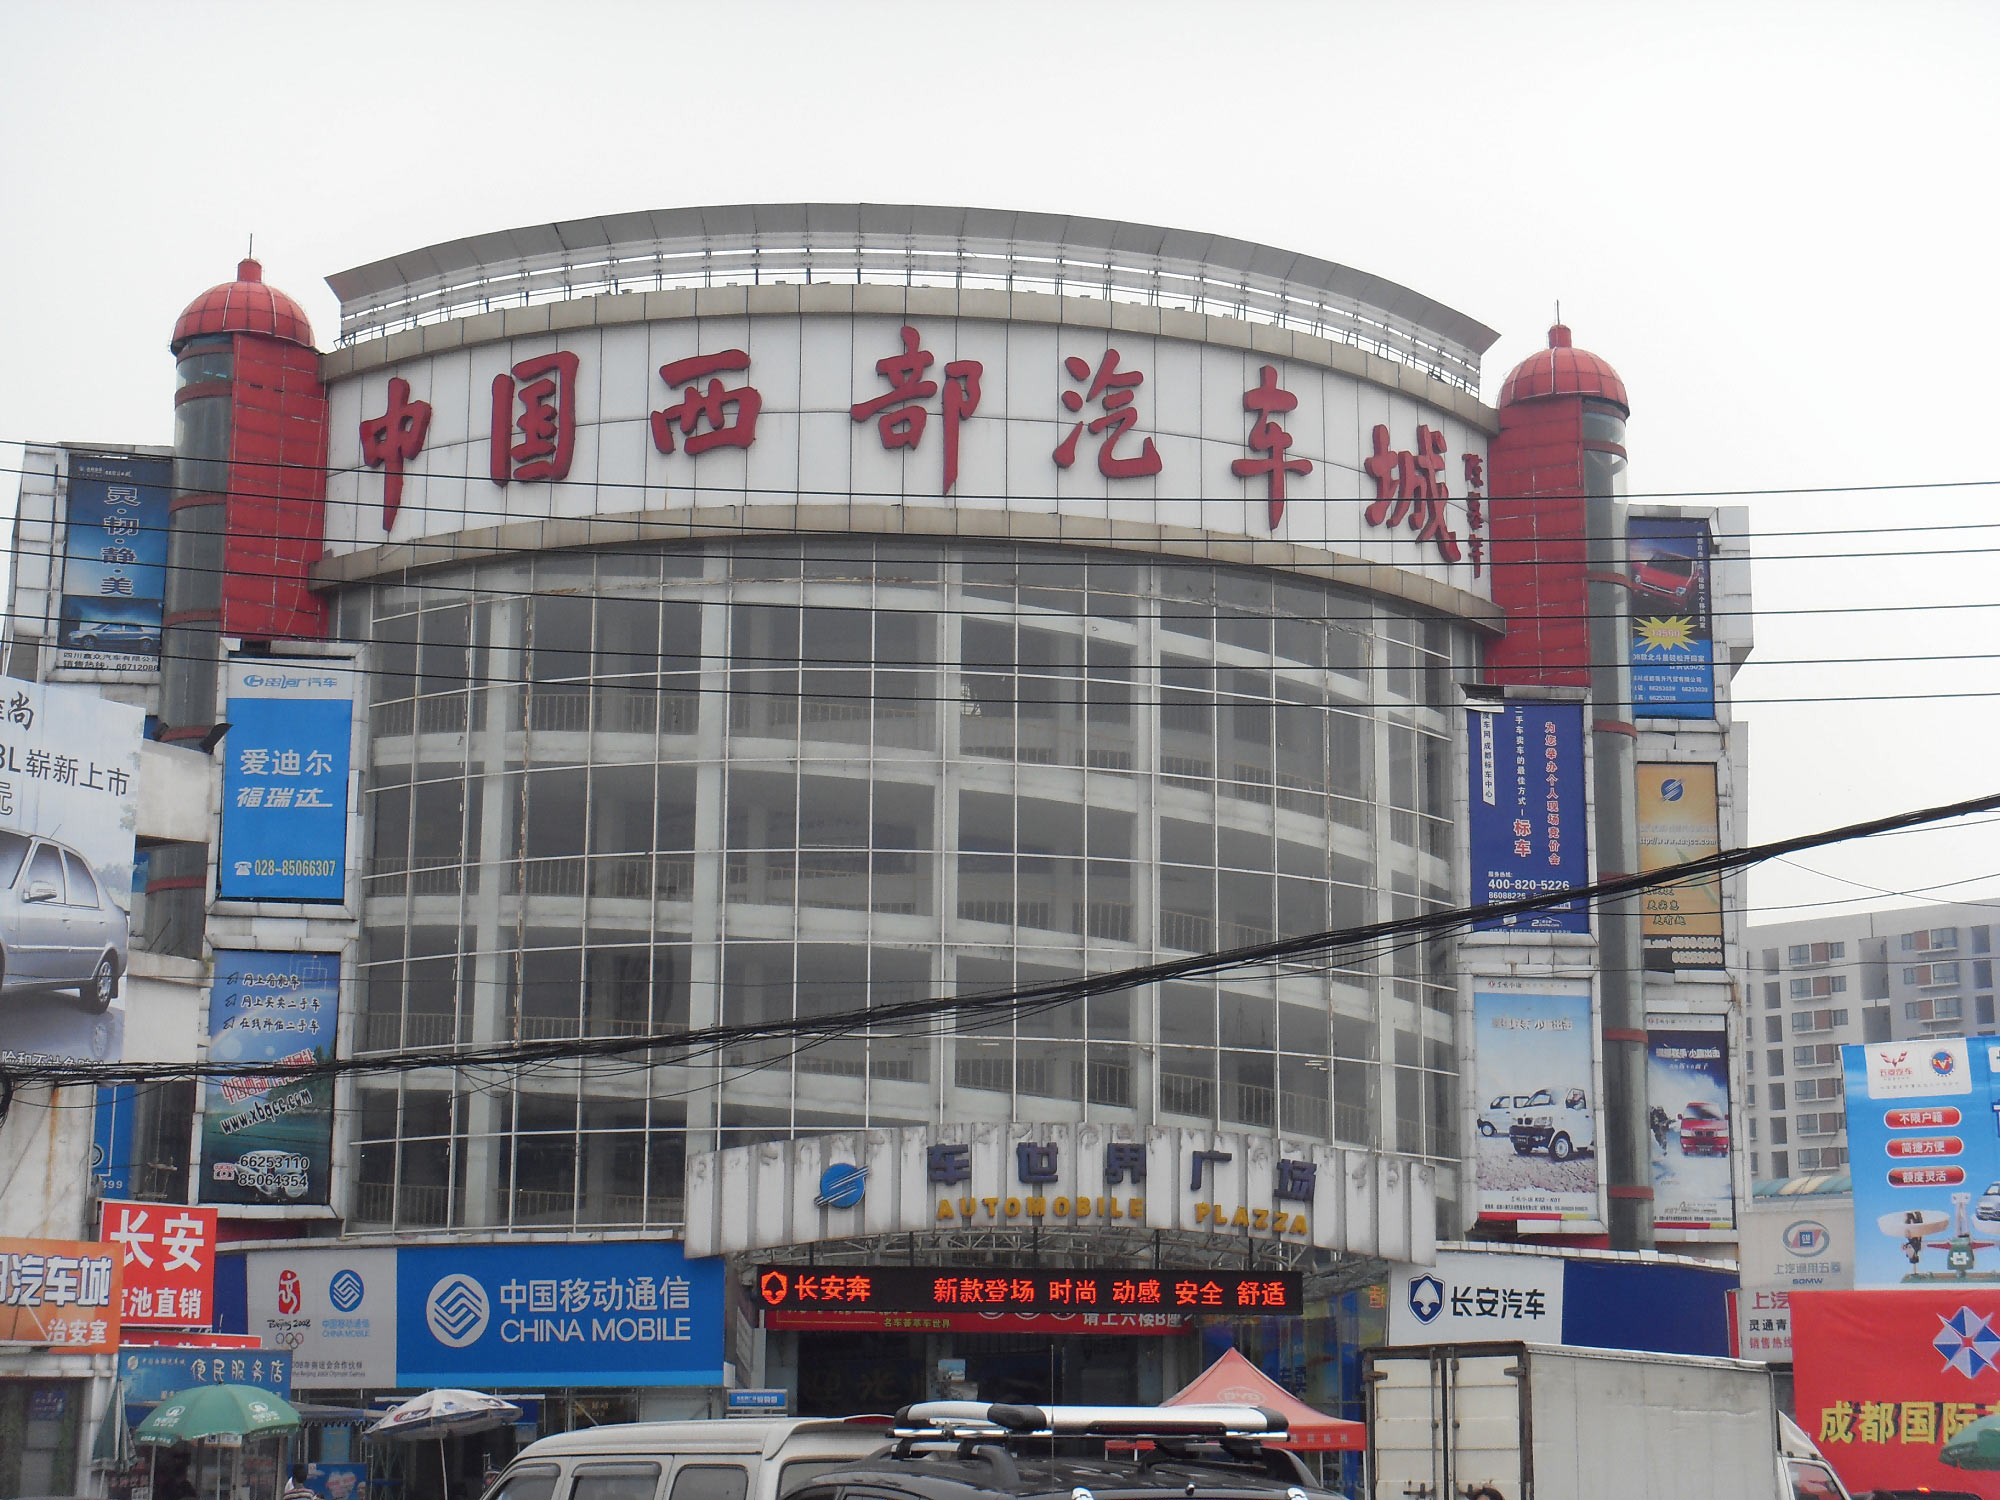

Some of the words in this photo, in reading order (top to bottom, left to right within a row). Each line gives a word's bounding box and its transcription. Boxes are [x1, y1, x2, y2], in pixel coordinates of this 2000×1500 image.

[359, 320, 1462, 563] 中国西部汽车城
[240, 749, 333, 776] 爱迪尔
[237, 787, 333, 808] 福瑞达
[254, 859, 336, 877] 028-85066307
[1488, 879, 1570, 891] 400-820-5226
[240, 994, 321, 1013] 网上买卖二手车
[239, 1017, 320, 1035] 在线评估二手车
[1899, 1111, 1943, 1125] 不限户籍
[1901, 1140, 1945, 1154] 简捷方便
[240, 1155, 310, 1169] 66253110
[927, 1141, 1317, 1202] 车世界广场
[238, 1174, 308, 1187] 85064354
[1902, 1169, 1947, 1184] 额度灵活
[937, 1196, 1145, 1219] AUTOMOBILE
[1195, 1202, 1308, 1235] PLAZZA
[109, 1208, 205, 1272] 长安
[500, 1275, 692, 1314] 中国移动通信
[794, 1275, 871, 1301] 长安奔
[933, 1277, 1035, 1303] 新款登场
[1048, 1279, 1098, 1304] 时尚
[1111, 1280, 1161, 1304] 动感
[1174, 1281, 1223, 1306] 安全
[1236, 1281, 1286, 1307] 舒适
[1450, 1285, 1546, 1320] 长安汽车
[48, 1318, 107, 1344] 治安室
[267, 1319, 292, 1331] Beijing
[500, 1318, 585, 1343] CHINA
[592, 1317, 692, 1342] MOBILE
